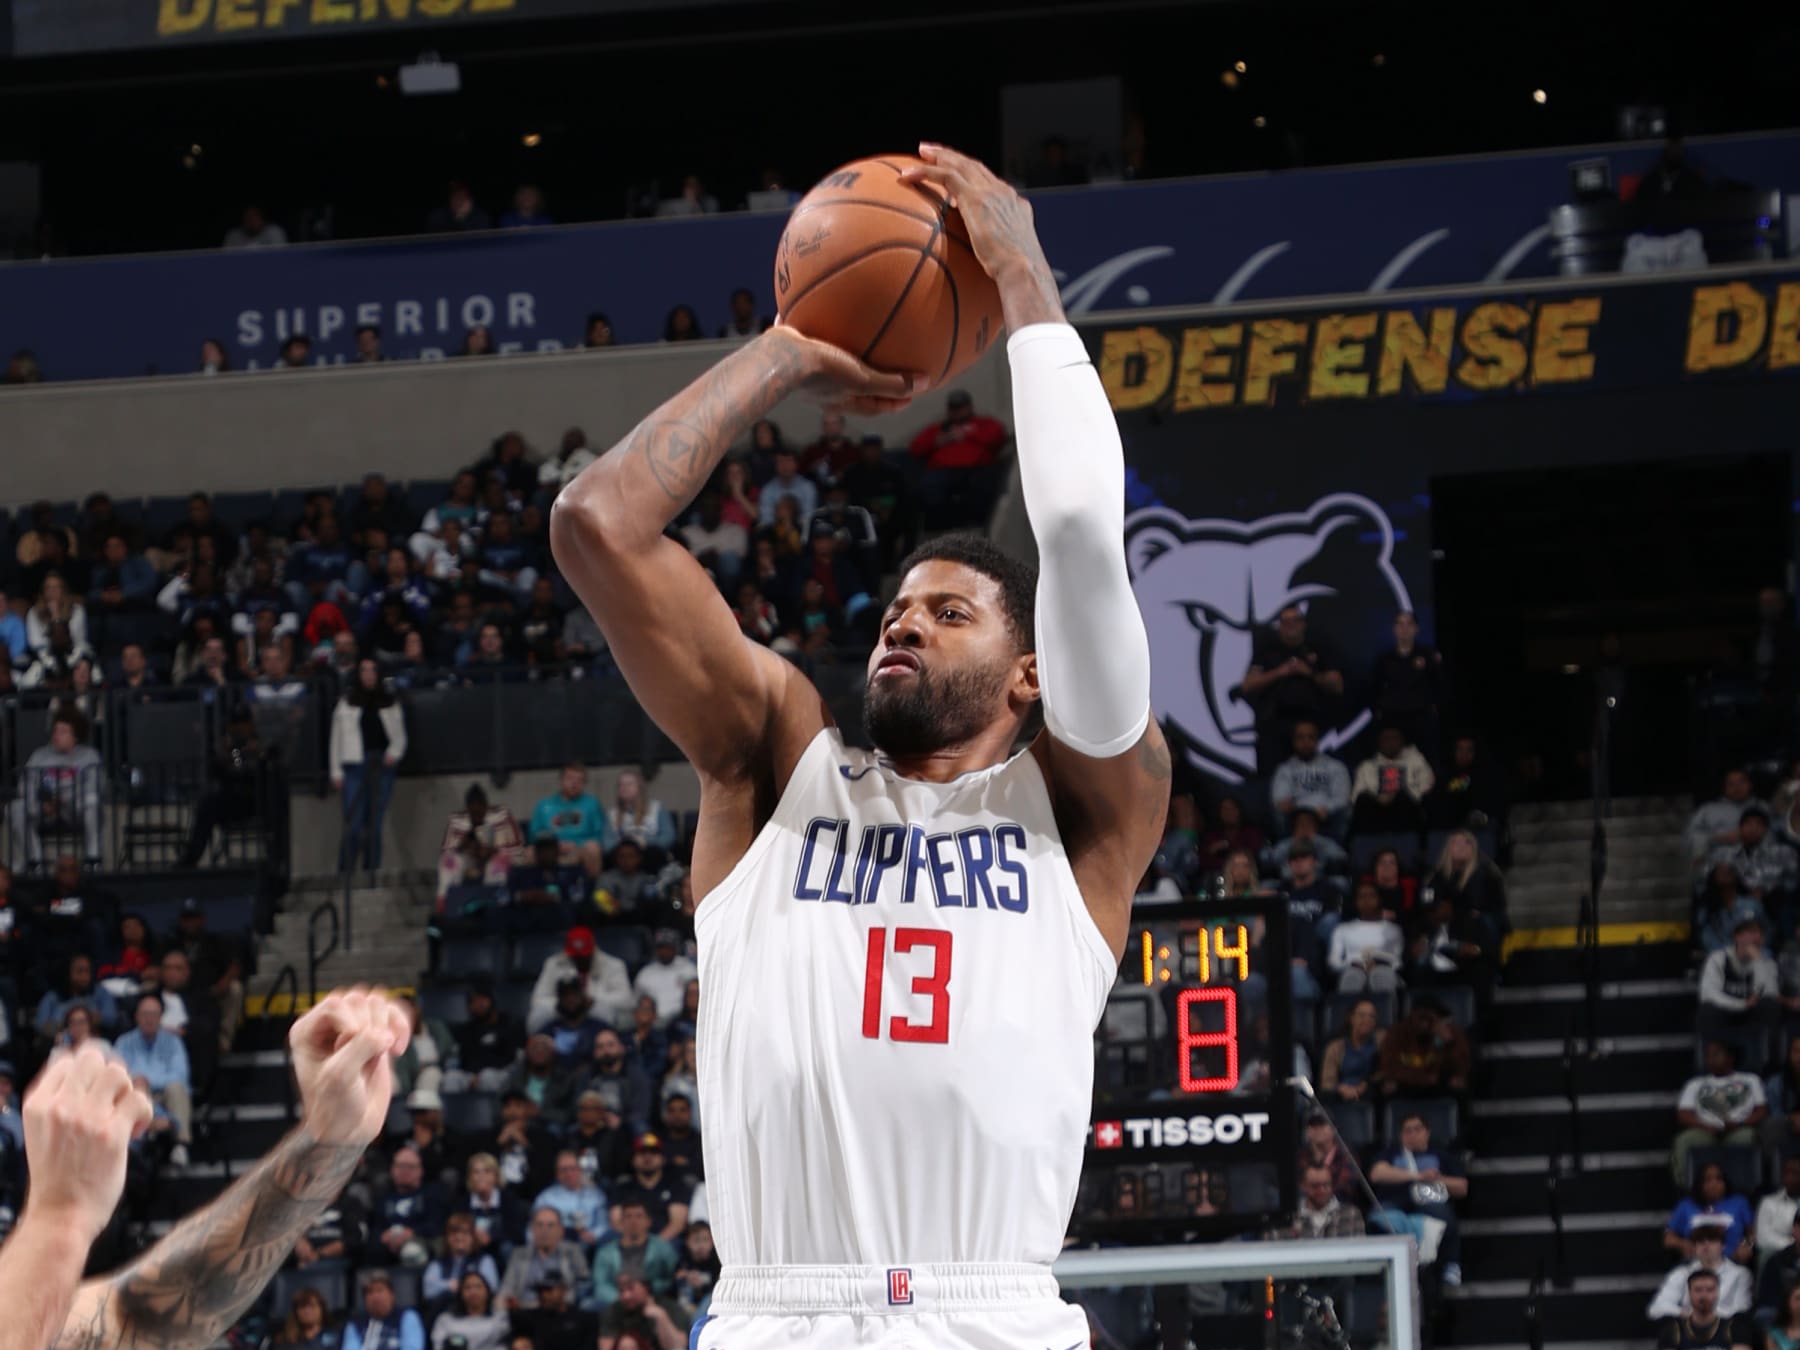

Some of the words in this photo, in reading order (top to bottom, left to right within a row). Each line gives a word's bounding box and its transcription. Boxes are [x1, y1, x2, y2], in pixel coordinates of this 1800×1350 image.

[237, 292, 536, 345] SUPERIOR
[1099, 297, 1602, 413] DEFENSE
[793, 816, 1029, 914] CLIPPERS
[861, 927, 953, 1044] 13
[1142, 924, 1249, 986] 1:14
[1177, 986, 1239, 1092] 8
[1125, 1112, 1269, 1148] TISSOT
